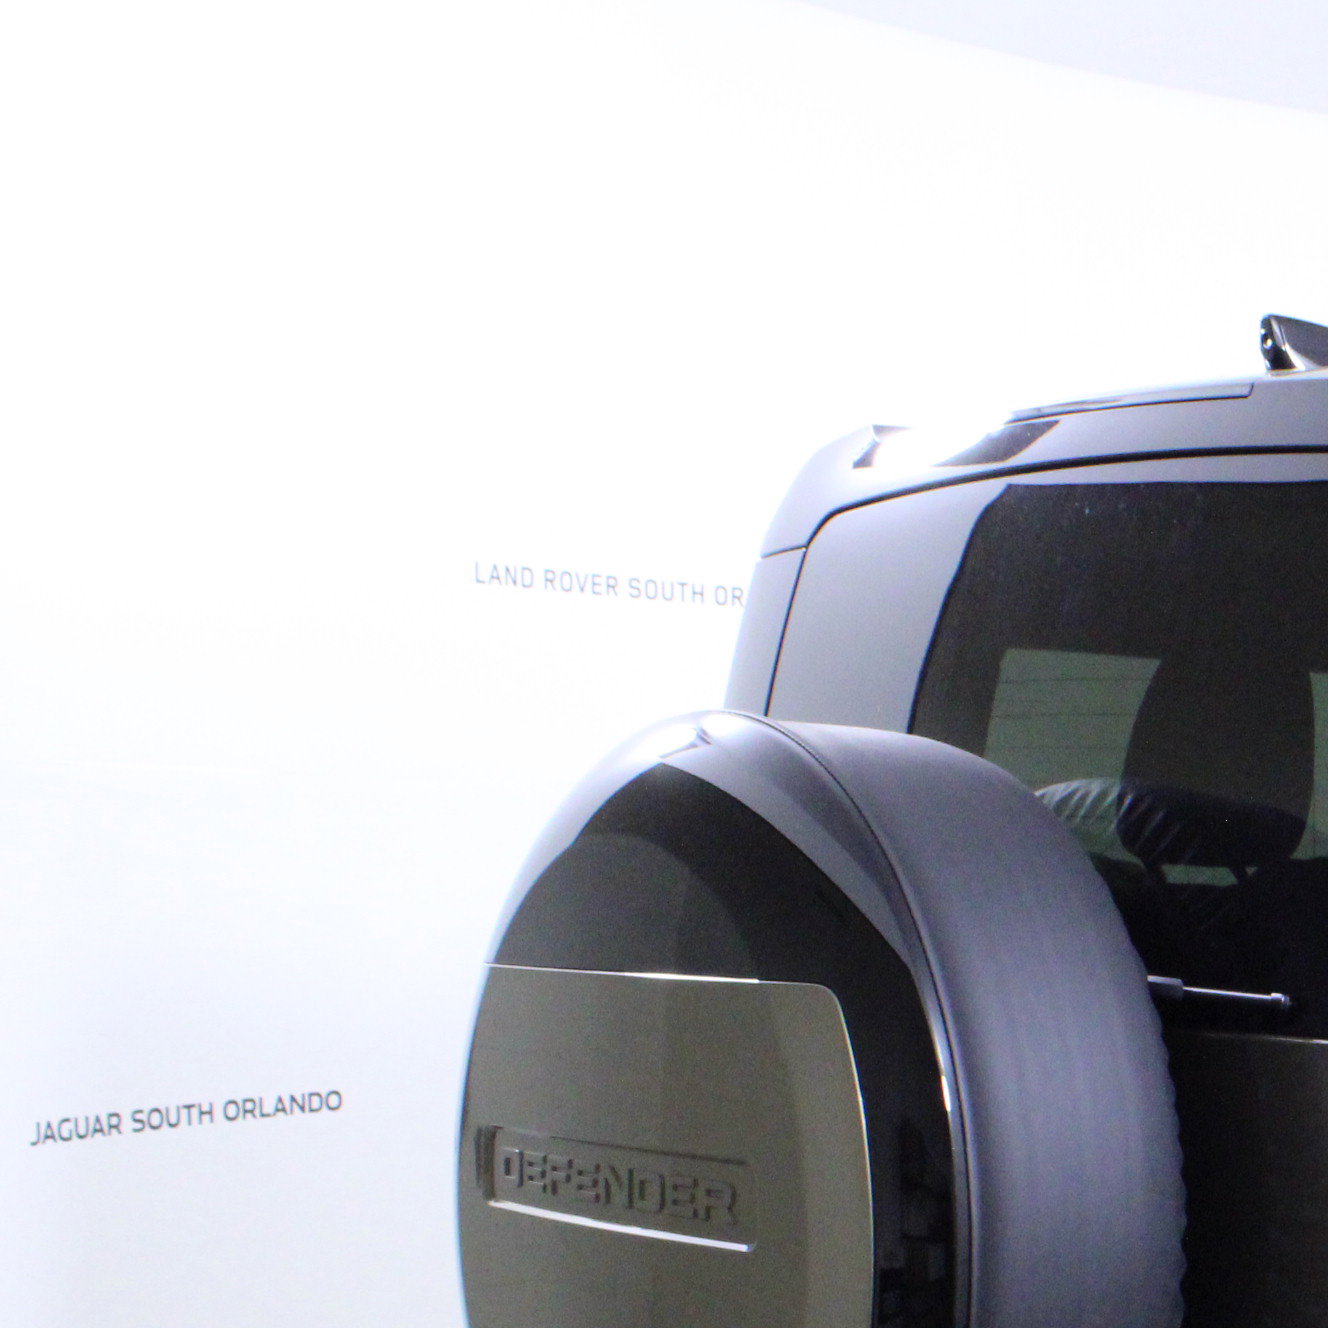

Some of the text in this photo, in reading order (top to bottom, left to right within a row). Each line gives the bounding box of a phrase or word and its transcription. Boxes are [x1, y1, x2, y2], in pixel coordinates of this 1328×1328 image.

[474, 561, 534, 589] LAND
[543, 568, 618, 597] ROVER
[627, 577, 705, 604] SOUTH
[30, 1090, 344, 1147] JAGUAR SOUTH ORLANDO
[500, 1147, 739, 1225] DEFENDER
